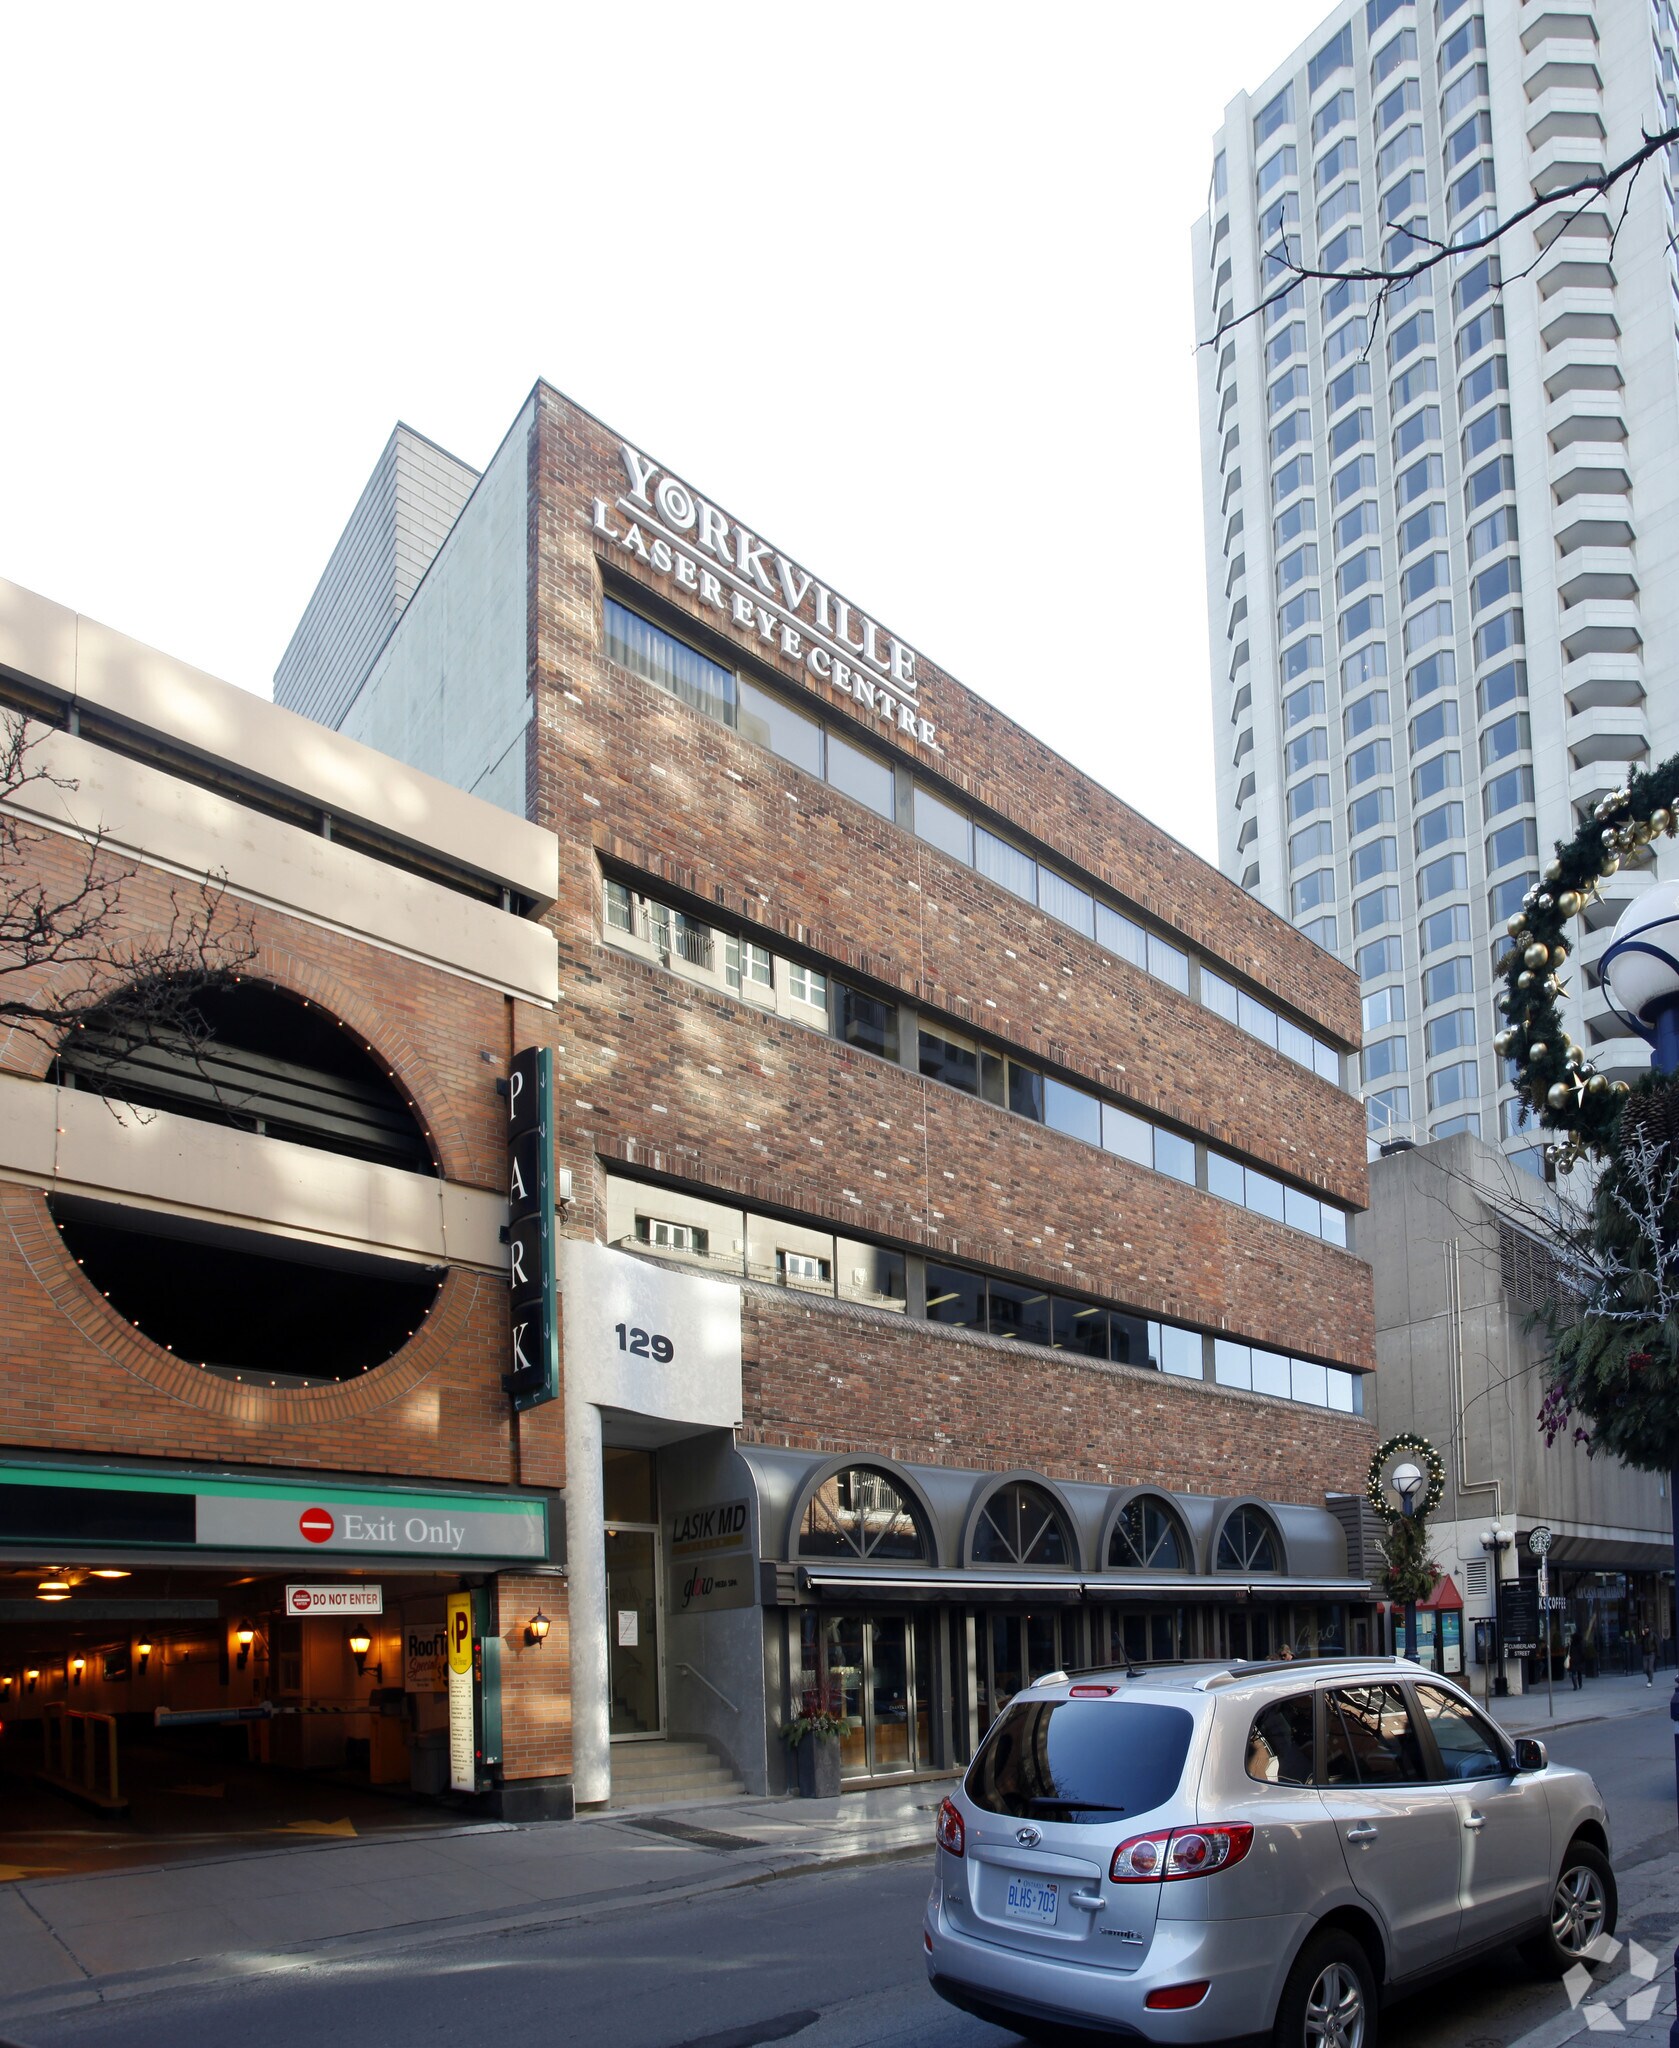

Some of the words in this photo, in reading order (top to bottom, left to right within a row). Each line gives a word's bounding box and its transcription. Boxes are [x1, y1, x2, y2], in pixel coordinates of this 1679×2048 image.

[619, 442, 918, 693] YORKVILLE
[592, 496, 724, 611] LASER
[730, 590, 803, 663] EYE
[807, 646, 938, 752] CENTRE
[508, 1070, 531, 1375] PARK
[614, 1322, 675, 1364] 129
[342, 1514, 397, 1541] Exit
[405, 1517, 466, 1551] Only
[673, 1510, 716, 1542] LASIK
[718, 1504, 746, 1535] MD
[313, 1593, 326, 1605] DO
[329, 1593, 347, 1605] NOT
[350, 1593, 378, 1605] ENTER
[681, 1566, 714, 1608] glow
[455, 1611, 469, 1653] P
[1008, 1885, 1033, 1908] BLHS
[1037, 1890, 1056, 1913] 703
